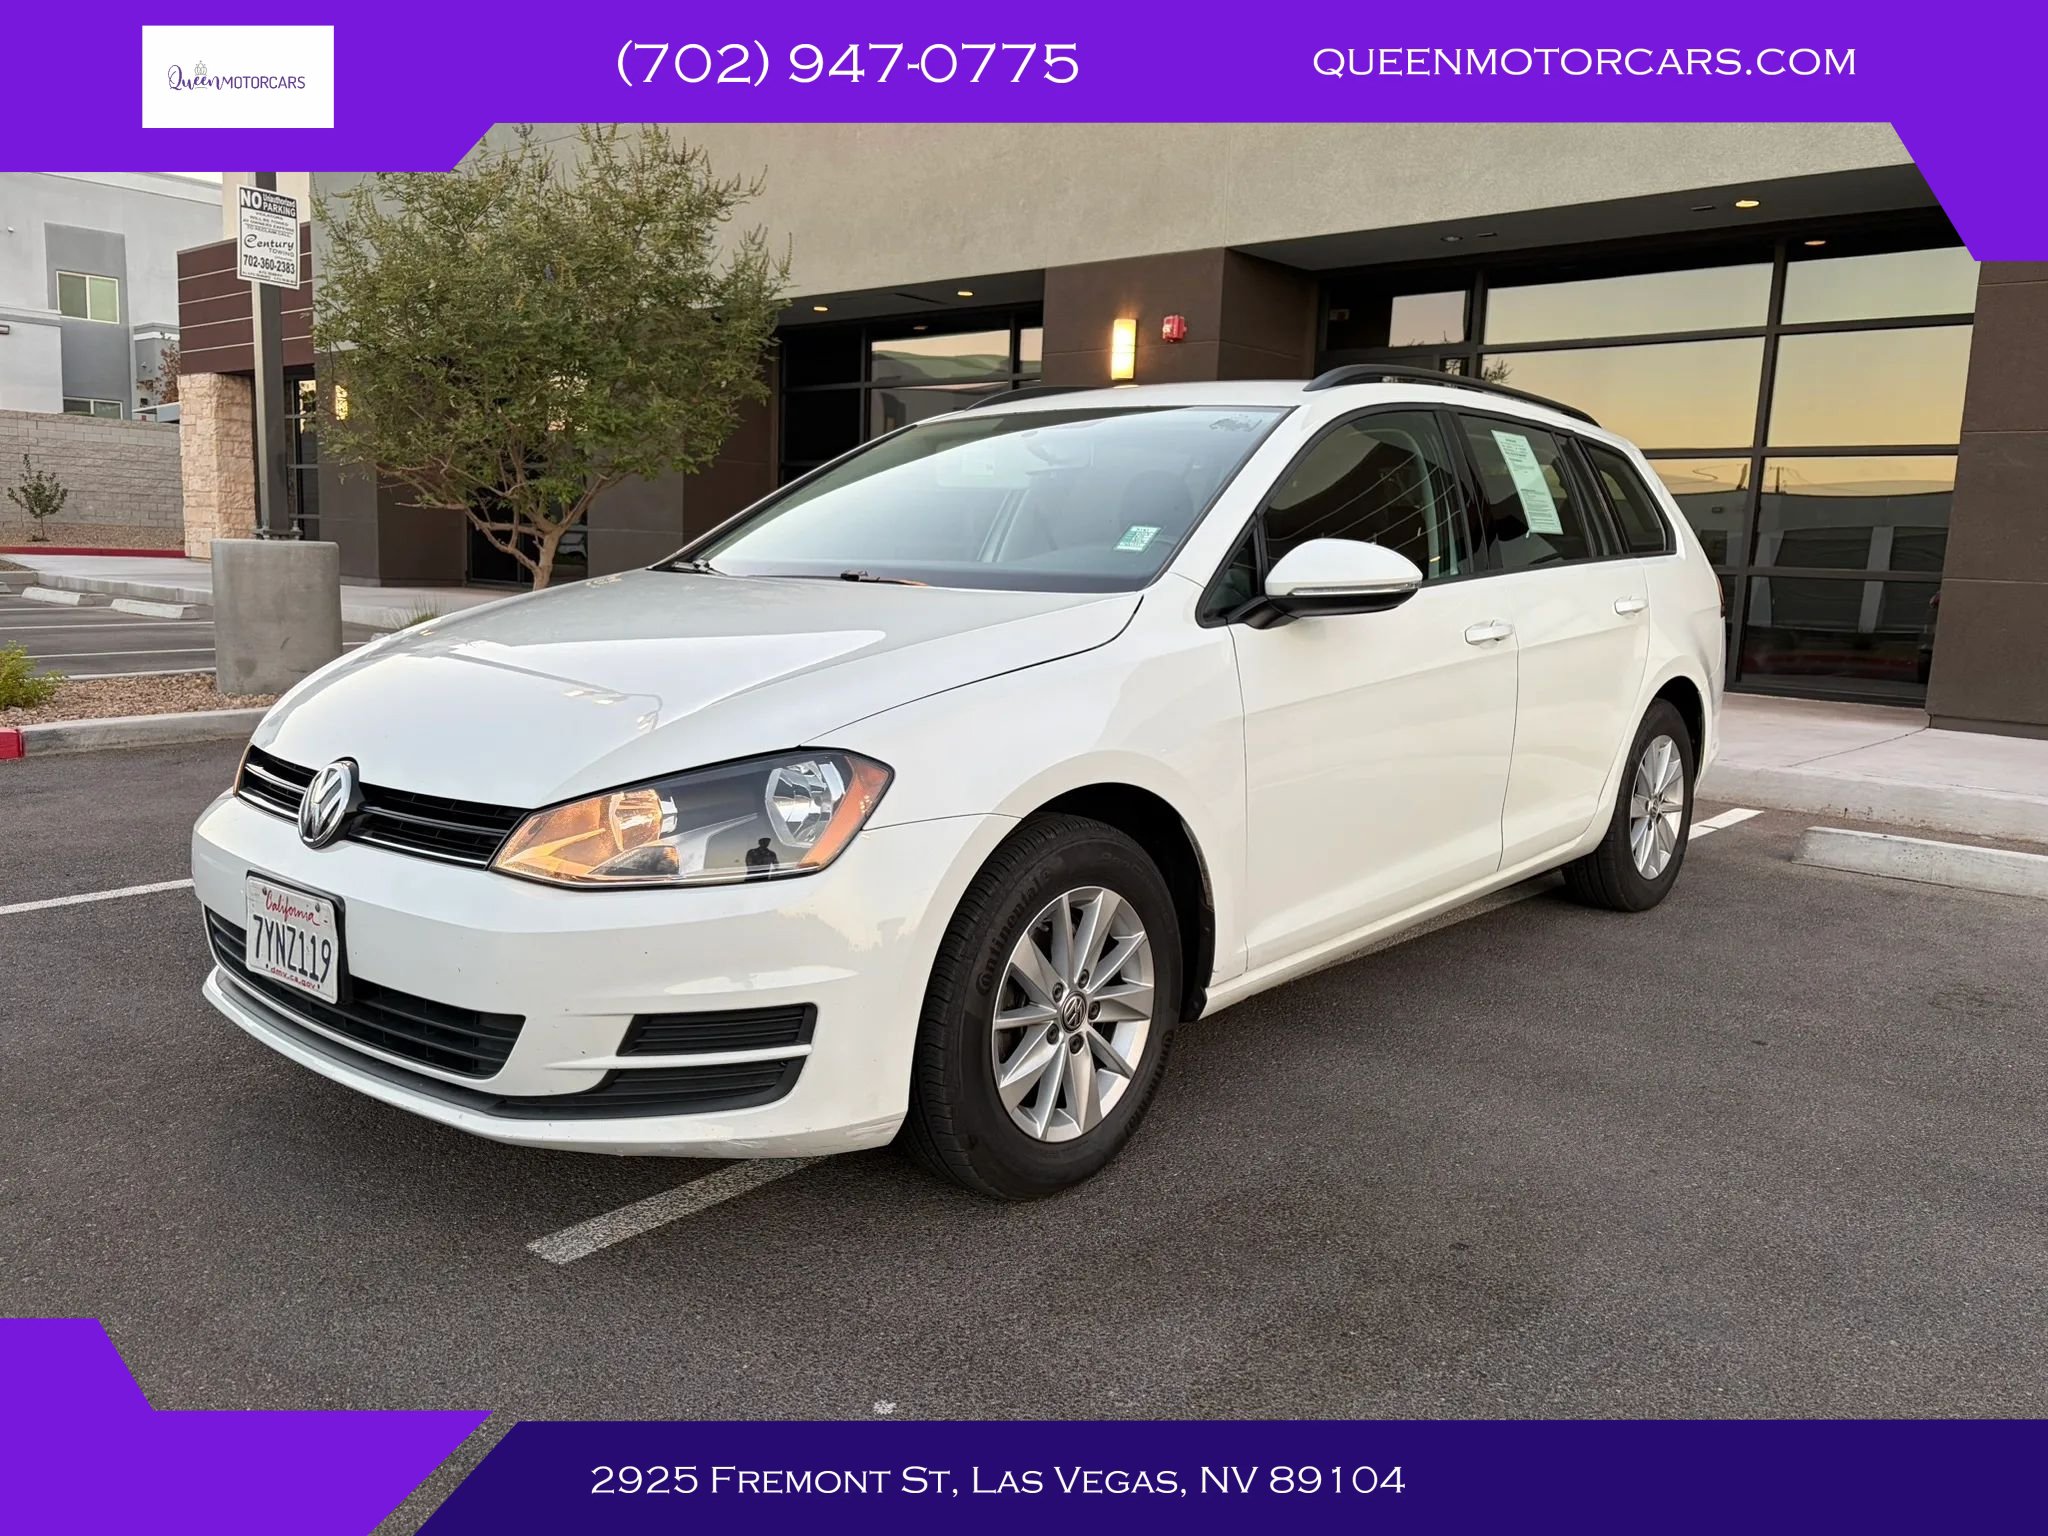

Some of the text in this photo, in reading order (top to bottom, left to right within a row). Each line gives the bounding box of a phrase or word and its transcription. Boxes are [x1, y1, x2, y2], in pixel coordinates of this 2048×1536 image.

[241, 189, 262, 209] NO
[262, 202, 296, 217] PARKING
[243, 233, 294, 251] Century
[268, 247, 295, 257] TOWING
[243, 254, 295, 274] 702-360-2383
[265, 889, 320, 926] California
[253, 914, 332, 984] 7YNZ119
[270, 967, 316, 990] dmv.ca.gov
